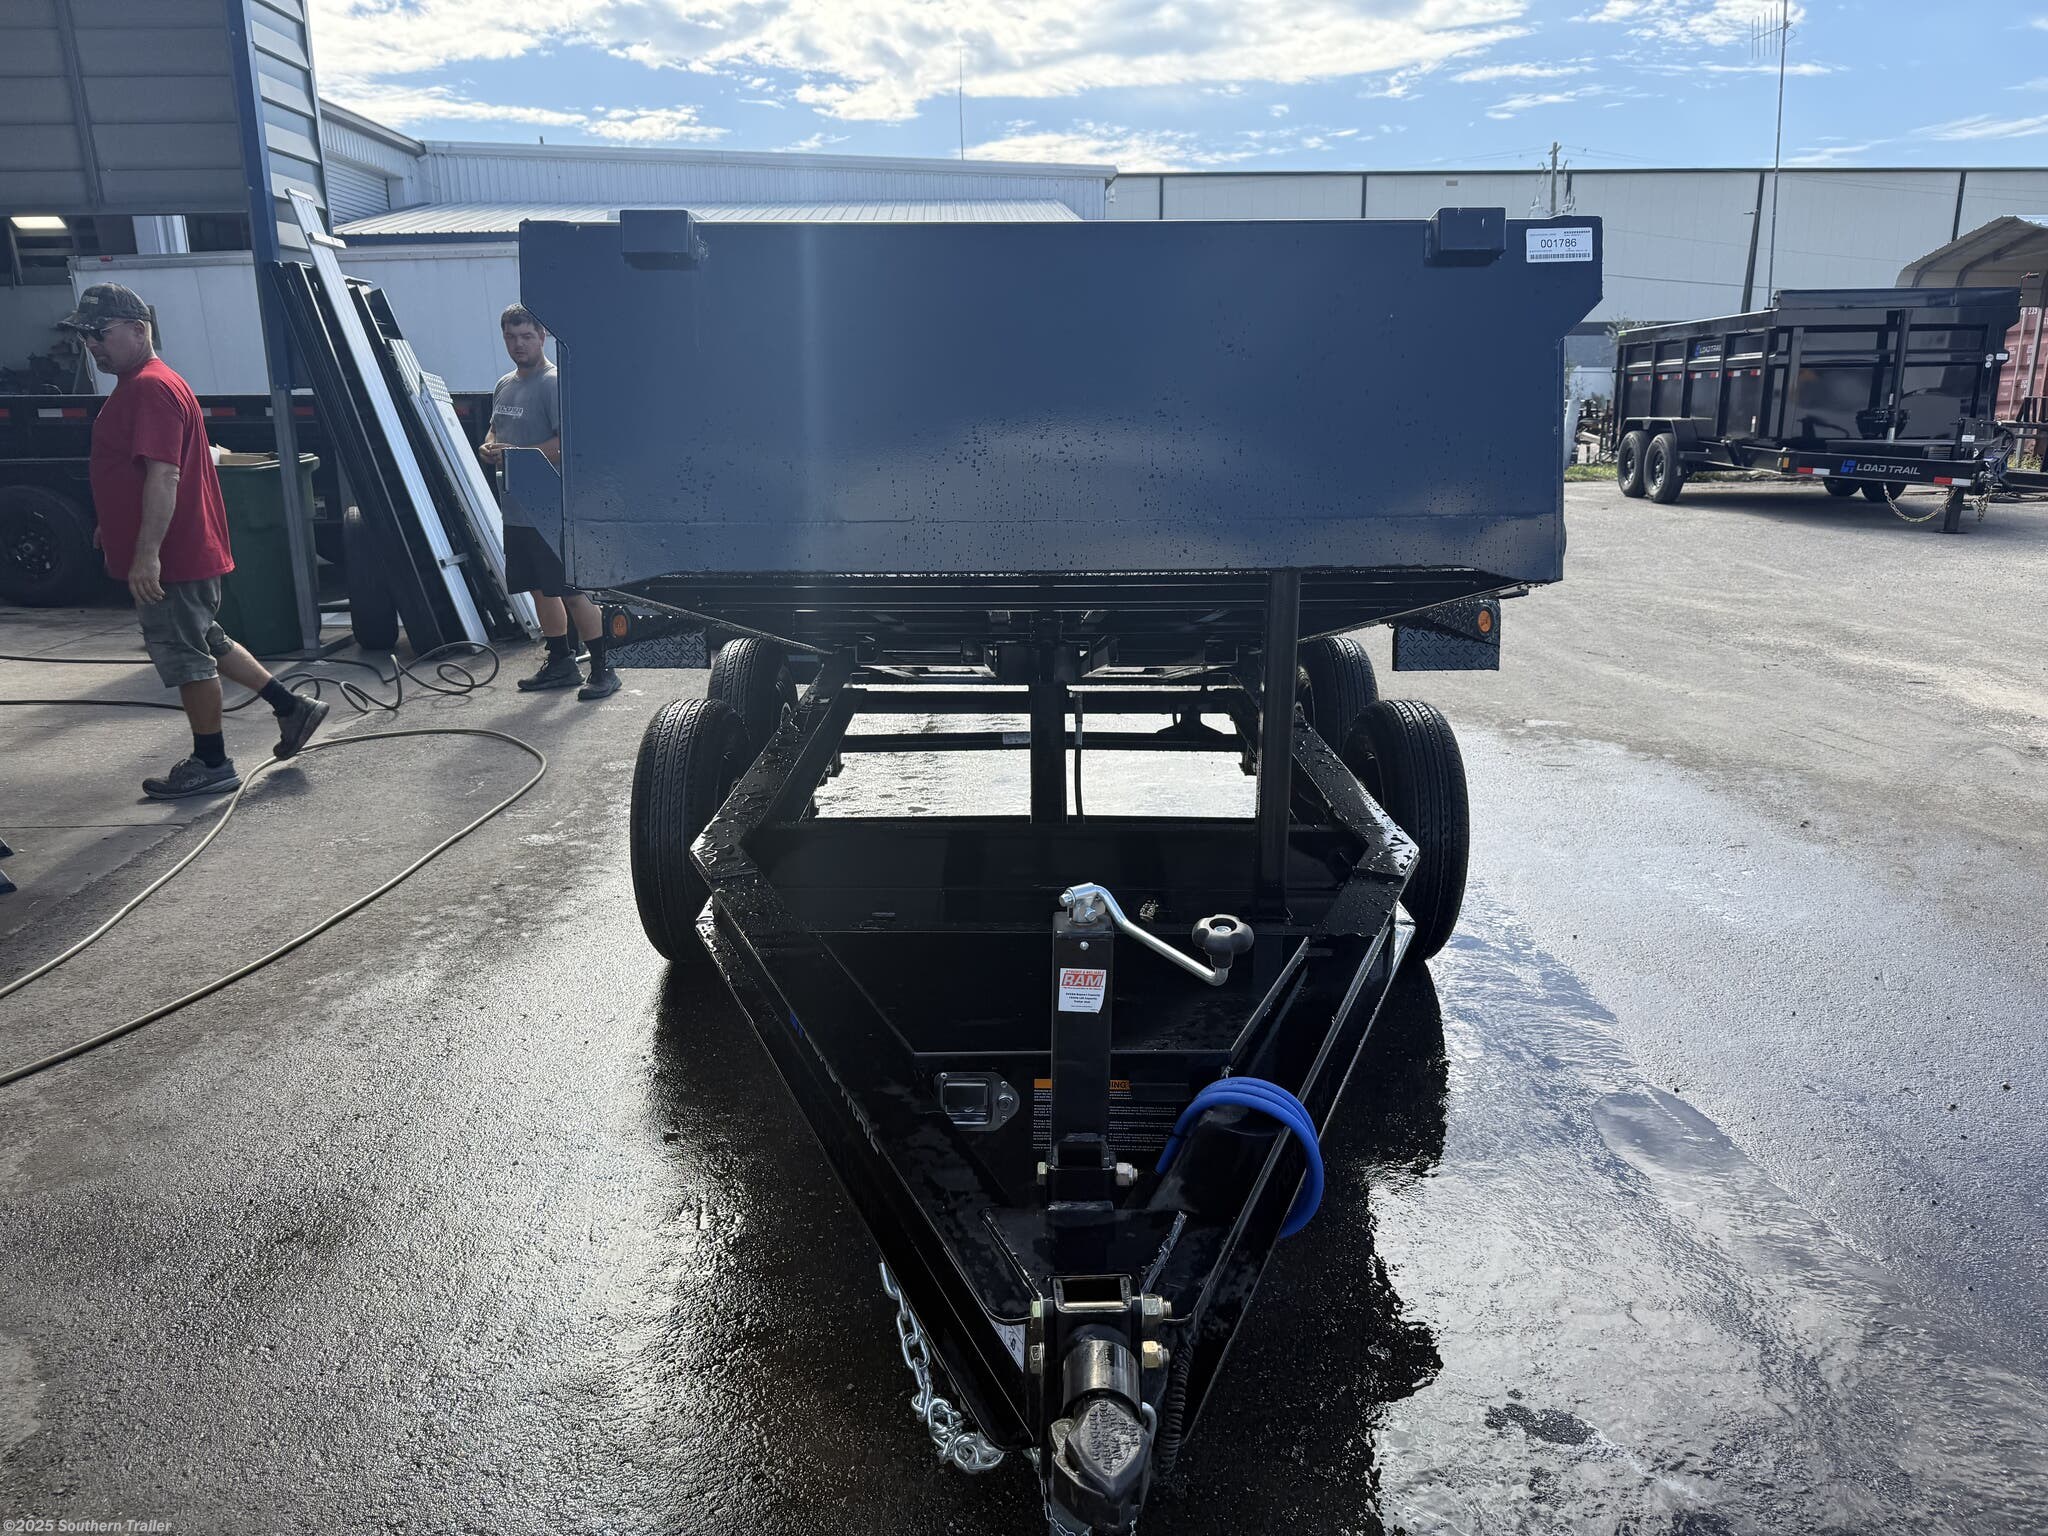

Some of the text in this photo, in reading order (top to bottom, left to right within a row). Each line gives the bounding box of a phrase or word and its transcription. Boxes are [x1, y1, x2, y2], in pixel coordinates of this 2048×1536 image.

[1540, 238, 1577, 249] 001786
[1856, 463, 1921, 475] LOAD TRAIL
[1063, 973, 1103, 987] RAM
